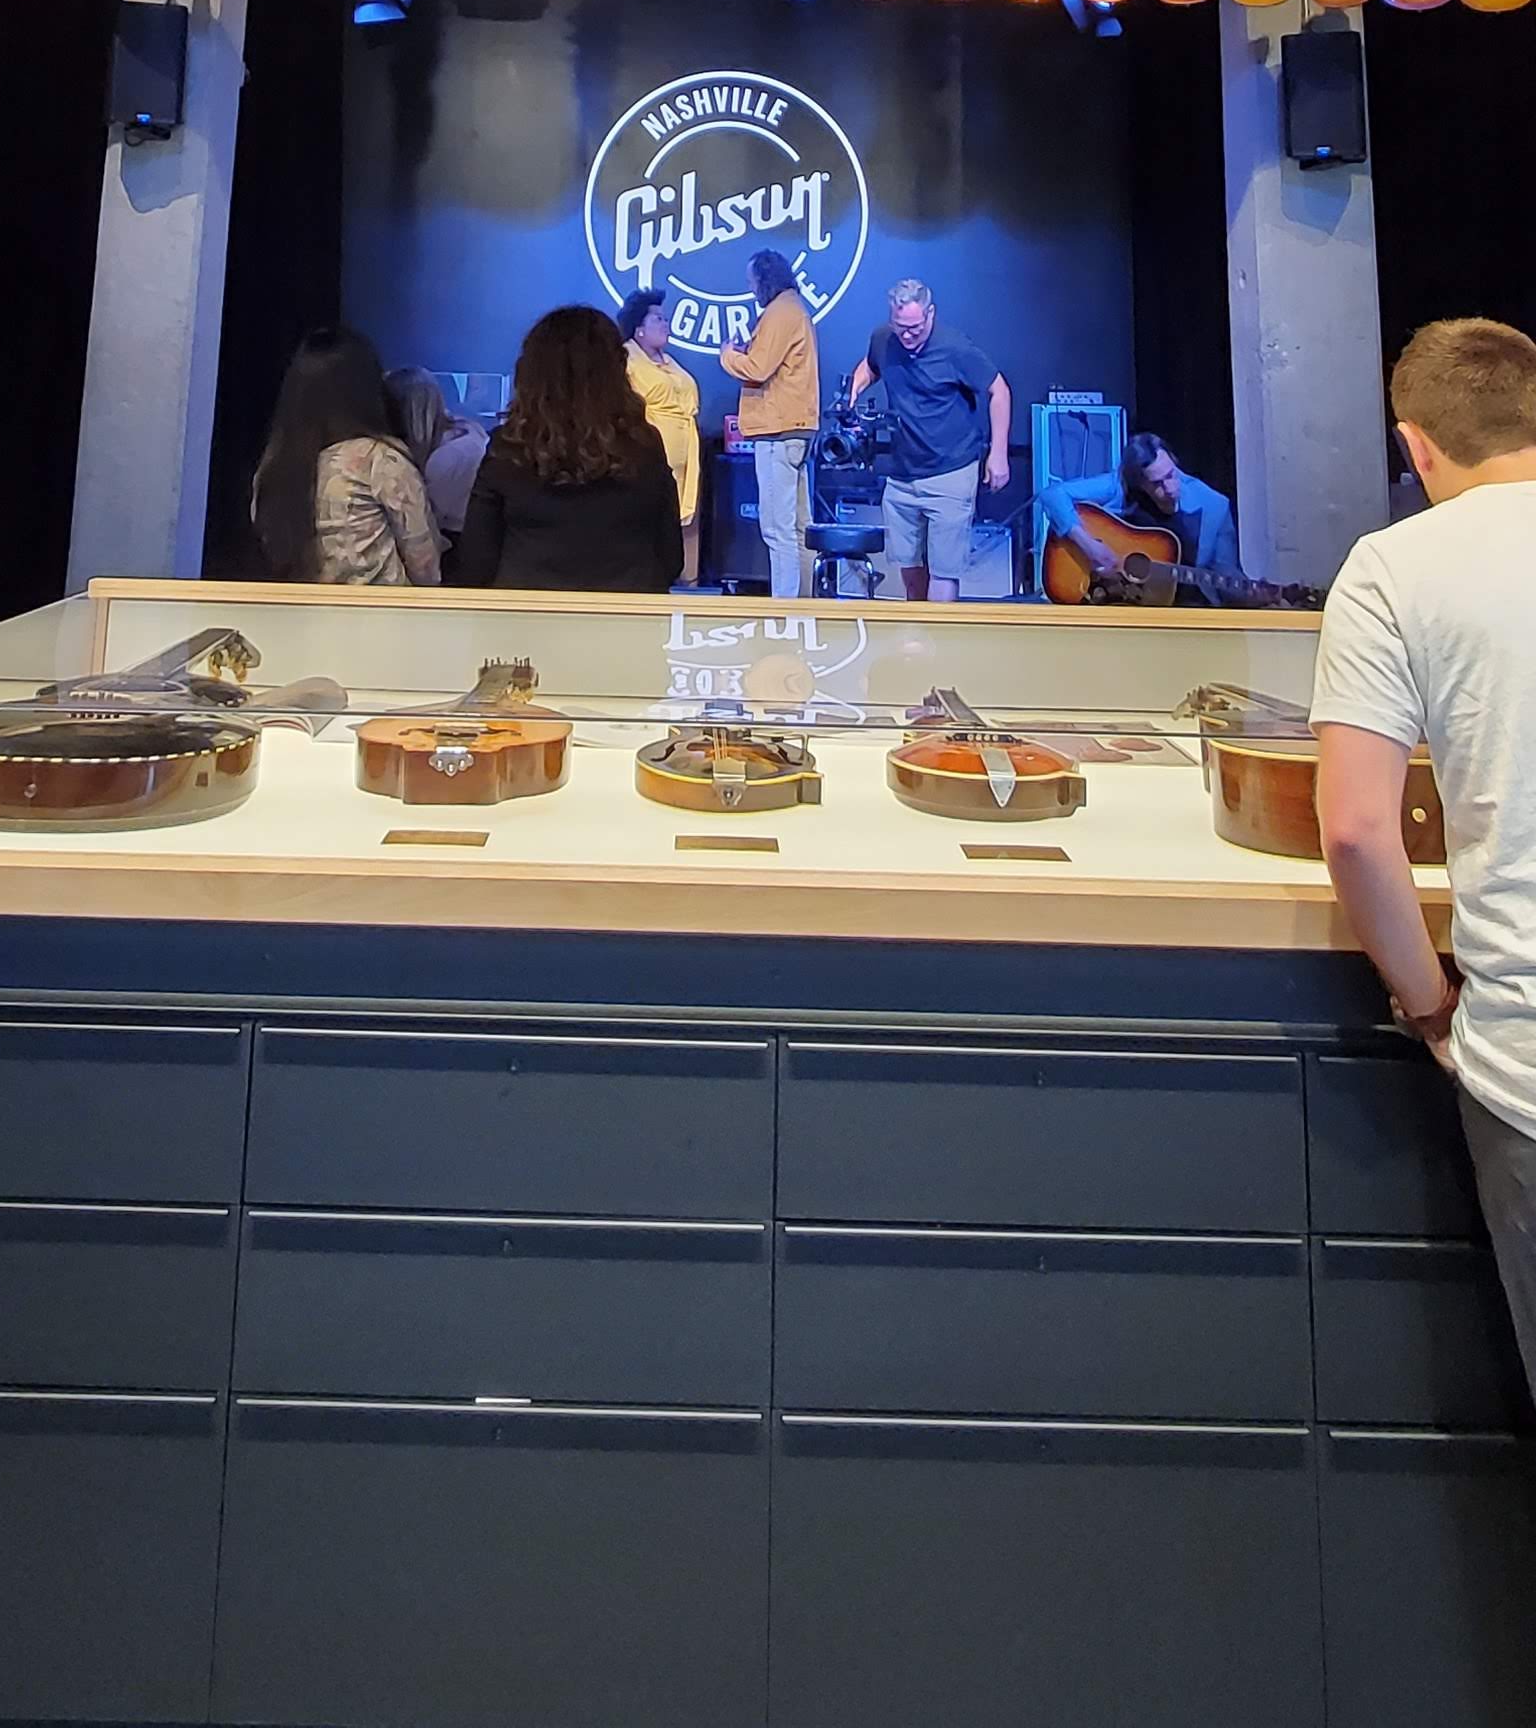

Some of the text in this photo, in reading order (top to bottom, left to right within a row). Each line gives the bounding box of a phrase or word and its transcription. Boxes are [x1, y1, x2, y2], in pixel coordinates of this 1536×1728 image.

[641, 86, 788, 141] NASHVILLE
[615, 171, 831, 292] Gibson
[670, 264, 828, 344] GARE
